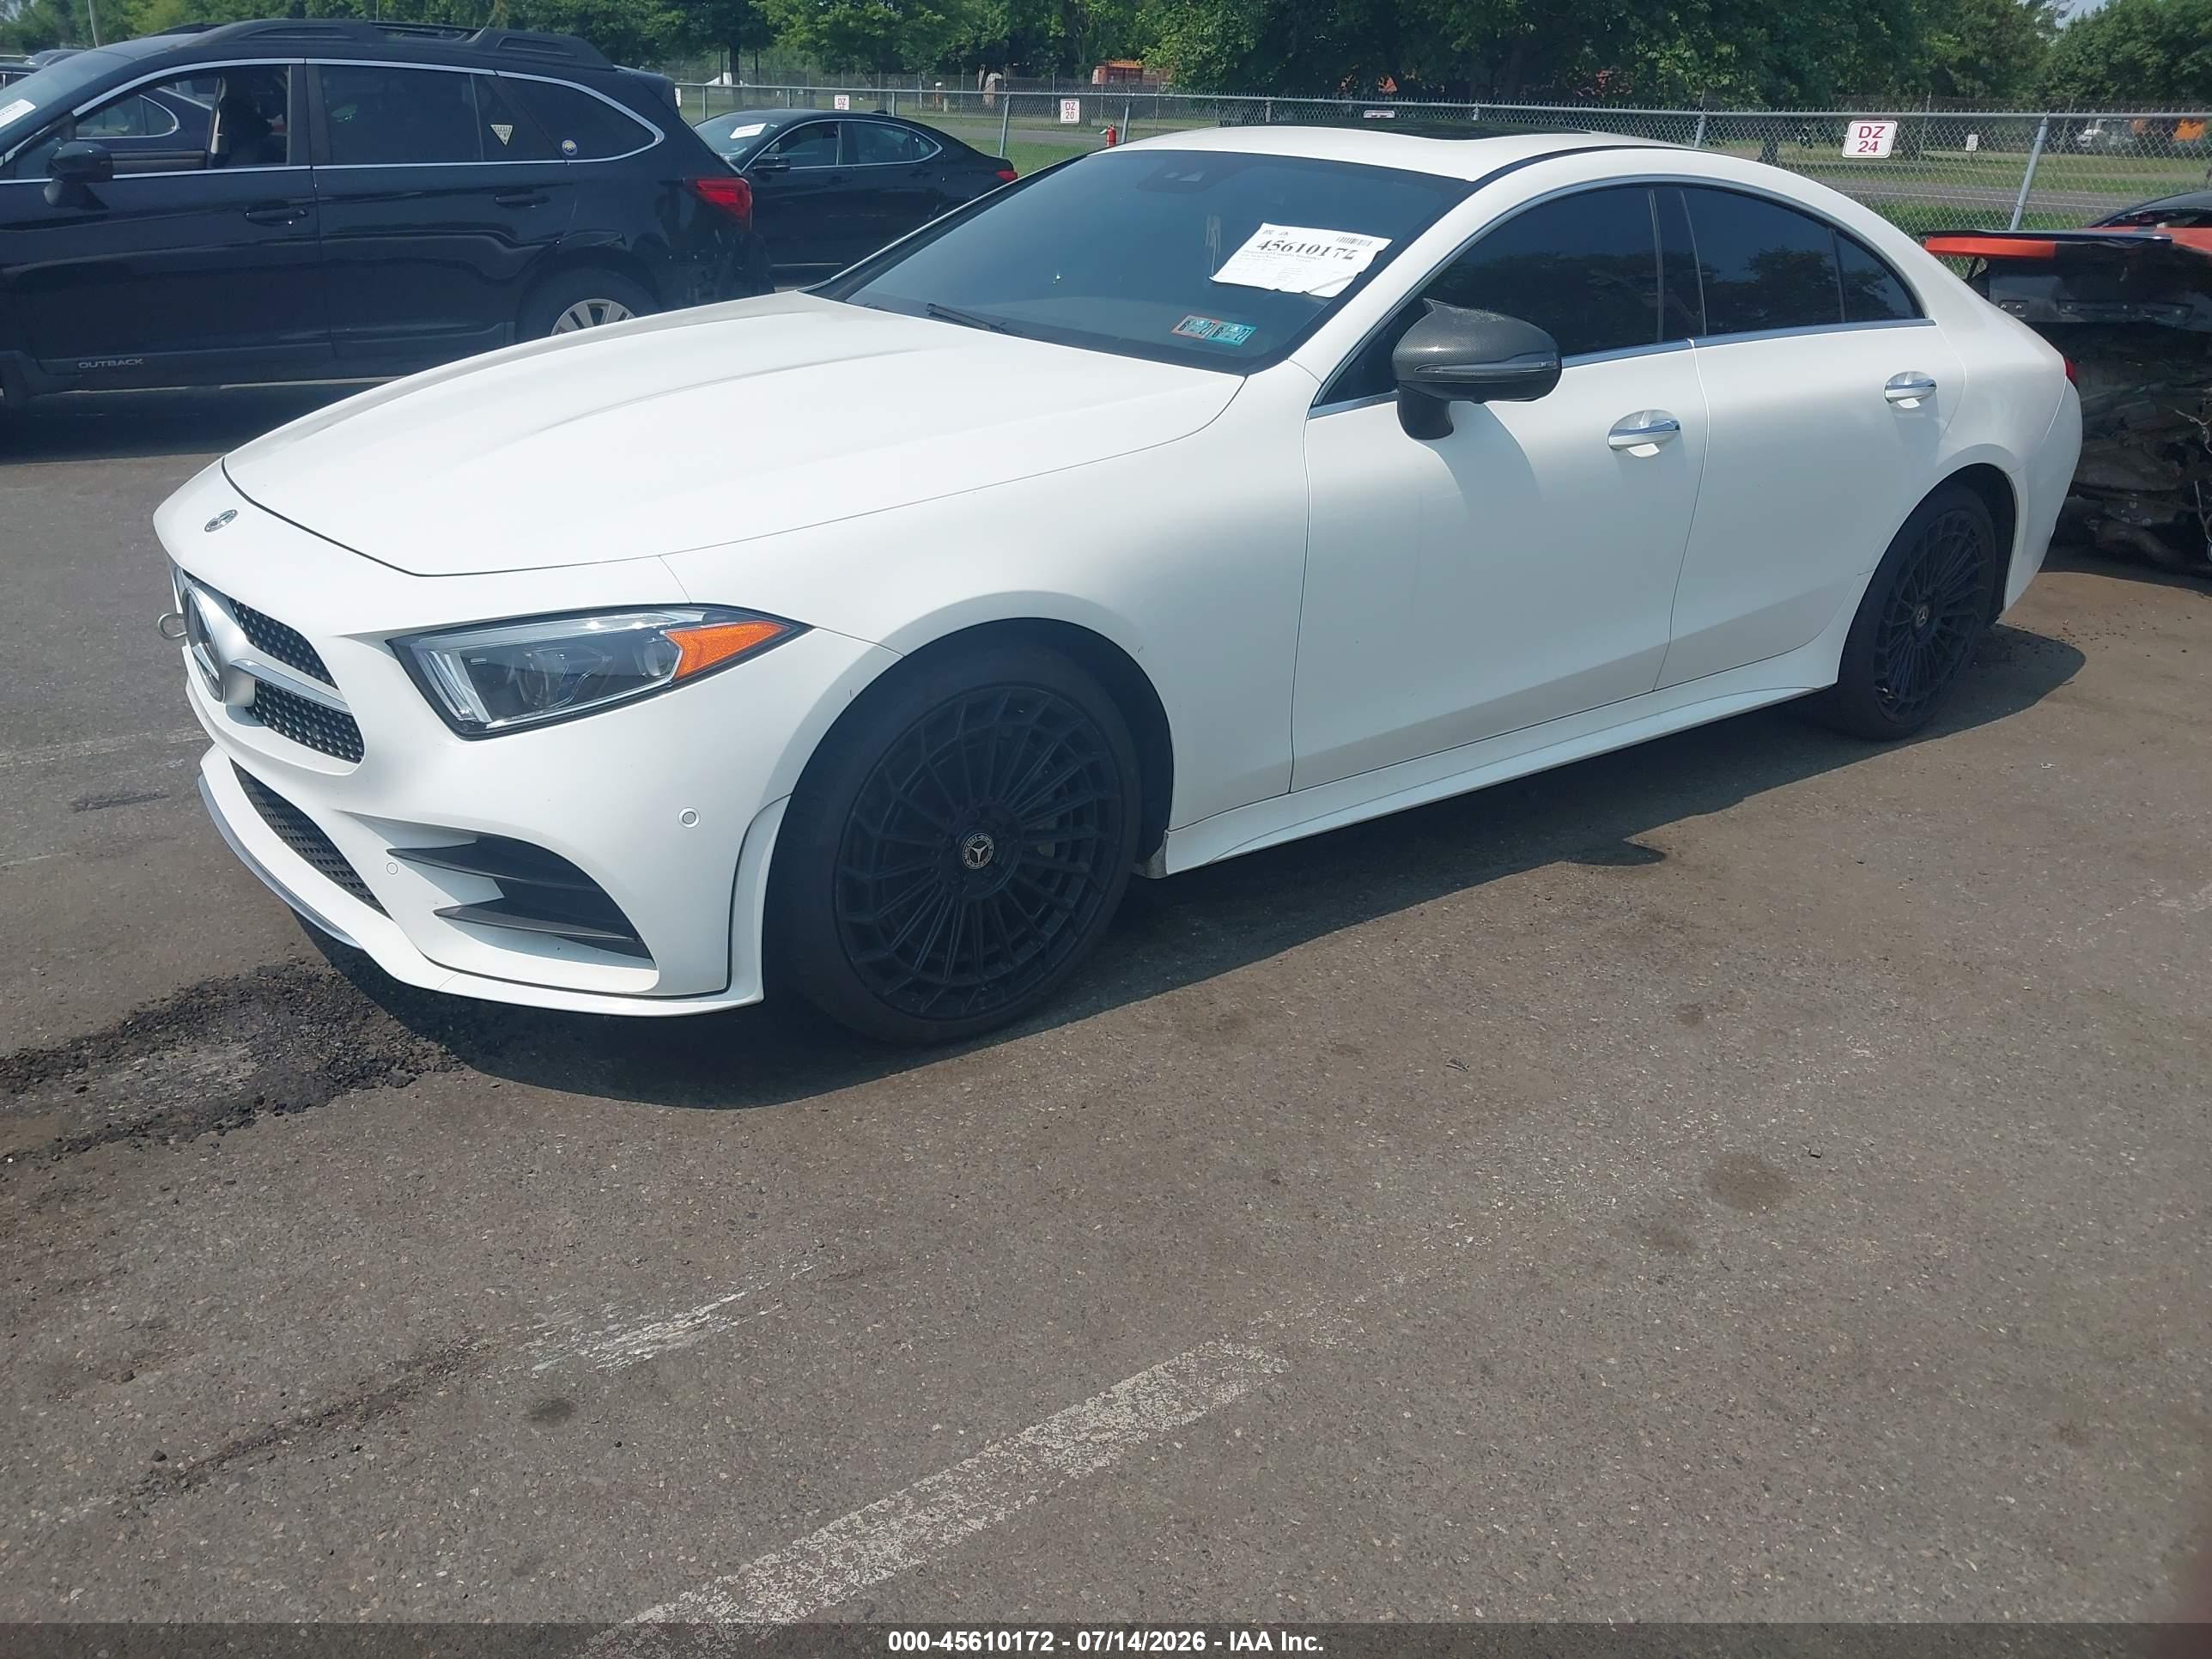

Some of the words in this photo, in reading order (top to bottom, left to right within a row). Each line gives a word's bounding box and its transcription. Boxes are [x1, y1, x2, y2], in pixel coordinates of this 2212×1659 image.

[1065, 102, 1076, 111] DZ
[1858, 125, 1886, 138] DZ
[1856, 140, 1879, 153] 24
[1256, 240, 1358, 260] 45610172
[78, 358, 144, 368] OUTBACK
